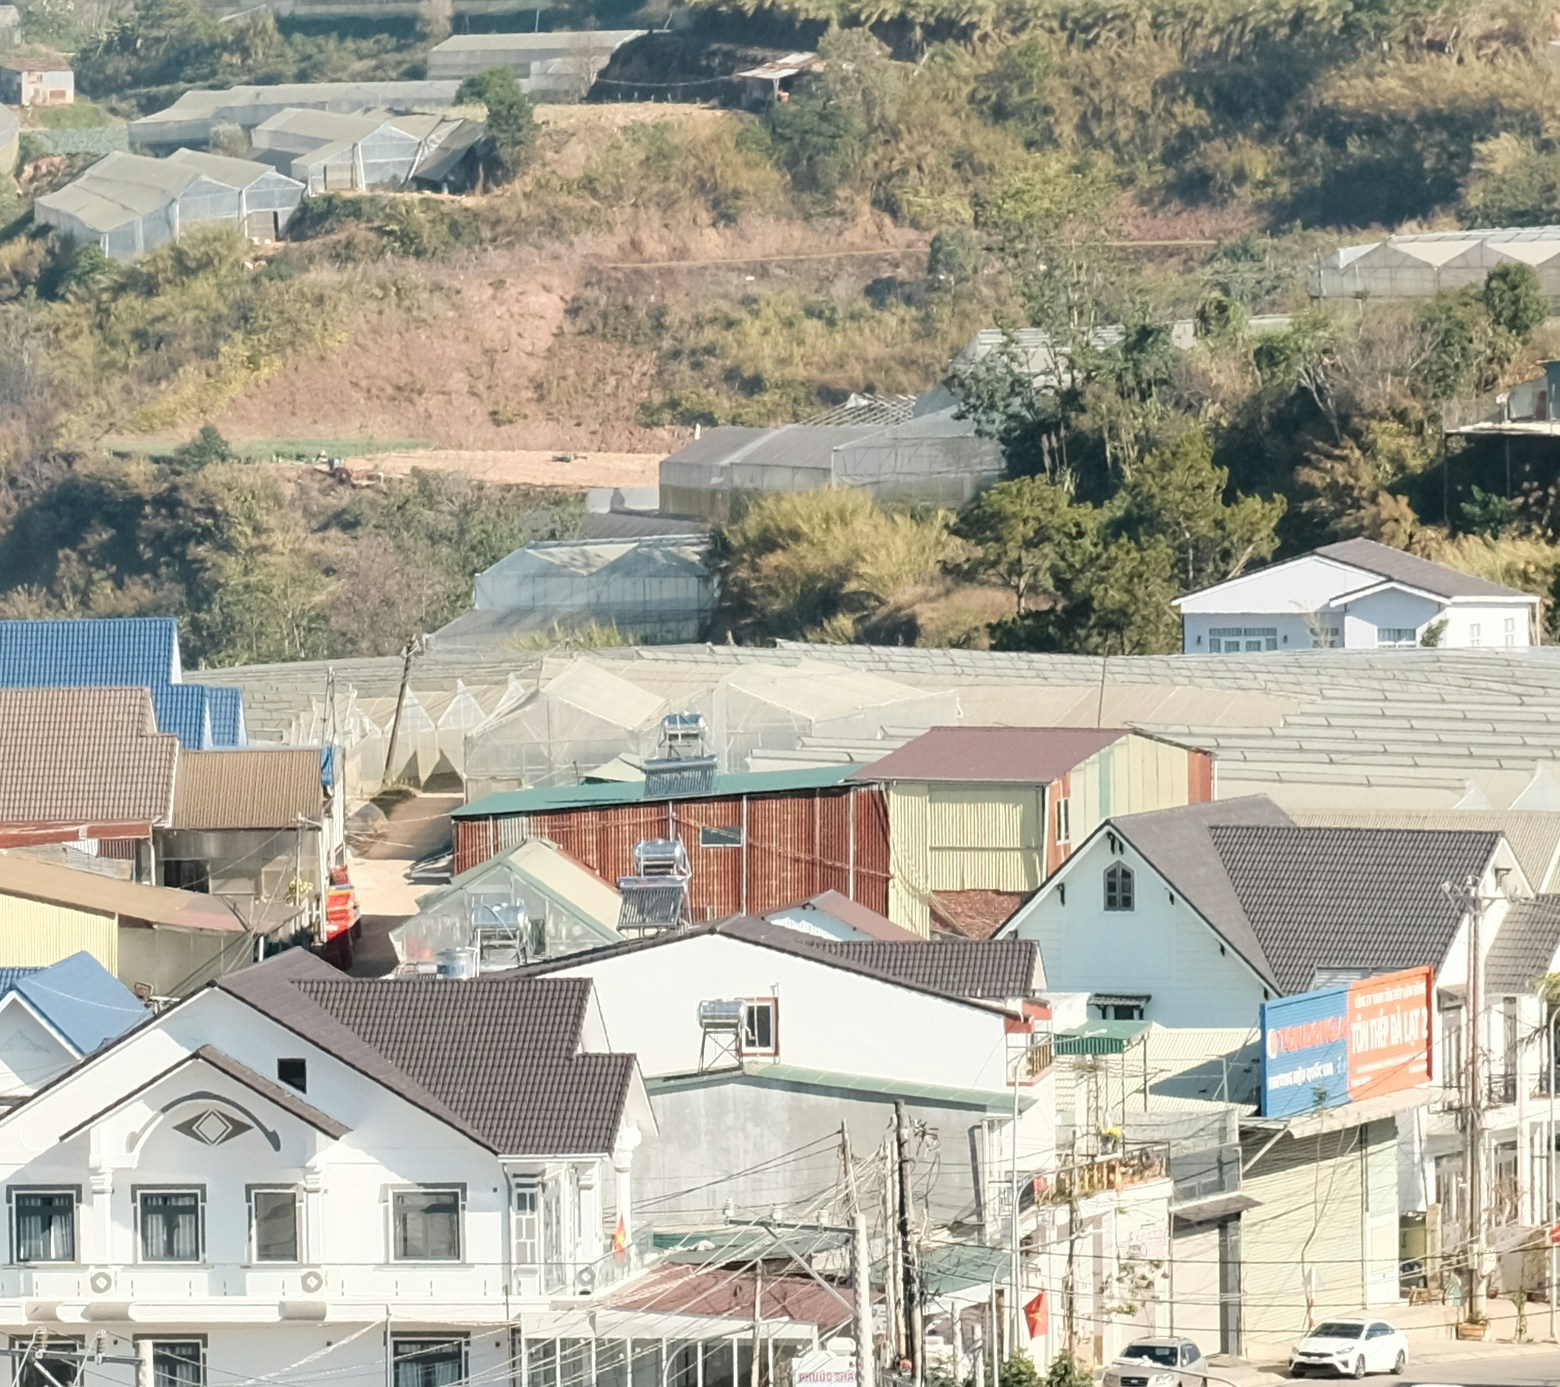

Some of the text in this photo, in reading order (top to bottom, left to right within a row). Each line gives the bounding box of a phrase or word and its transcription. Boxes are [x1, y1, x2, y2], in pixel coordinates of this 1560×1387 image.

[1351, 1013, 1369, 1054] TÔN
[1369, 1008, 1390, 1050] THÉP
[1404, 1008, 1421, 1047] LẠT
[1306, 1061, 1323, 1082] QUỐC
